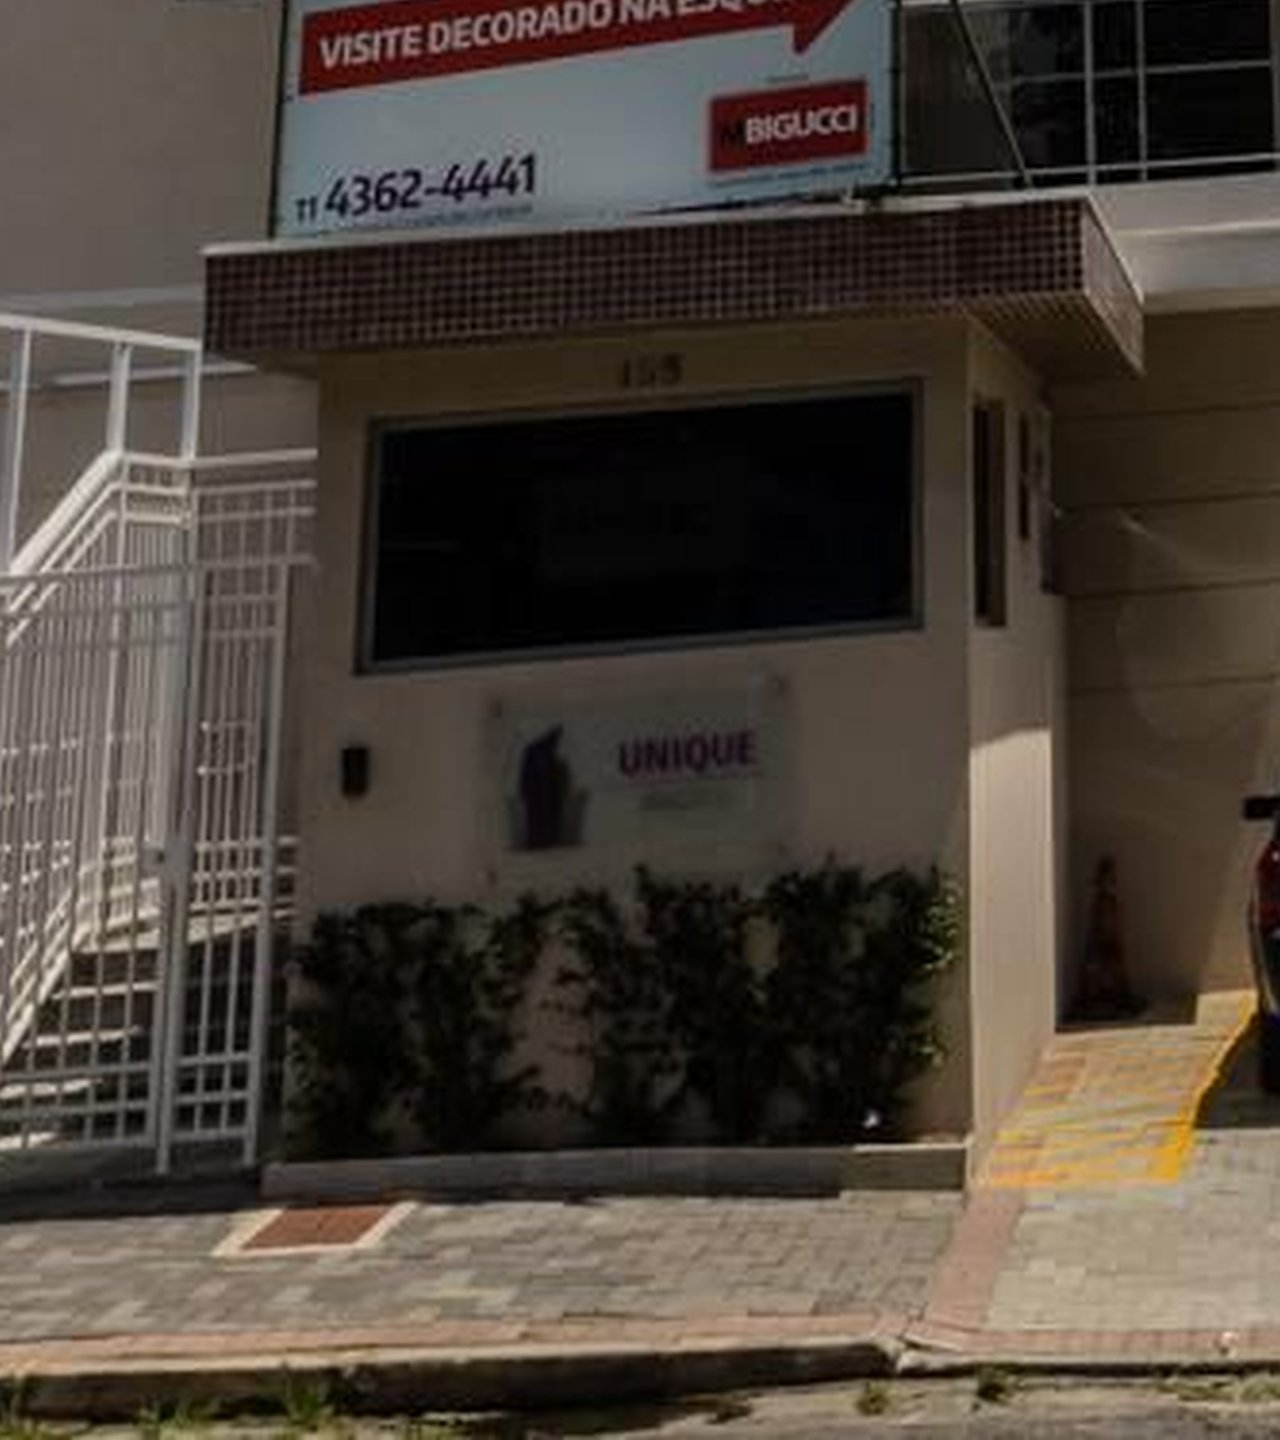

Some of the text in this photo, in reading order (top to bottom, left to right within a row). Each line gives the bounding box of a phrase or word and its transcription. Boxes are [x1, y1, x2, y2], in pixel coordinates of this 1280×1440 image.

[320, 23, 422, 69] VISITE
[326, 152, 537, 219] 4362-4441
[619, 729, 758, 776] UNIQUE
